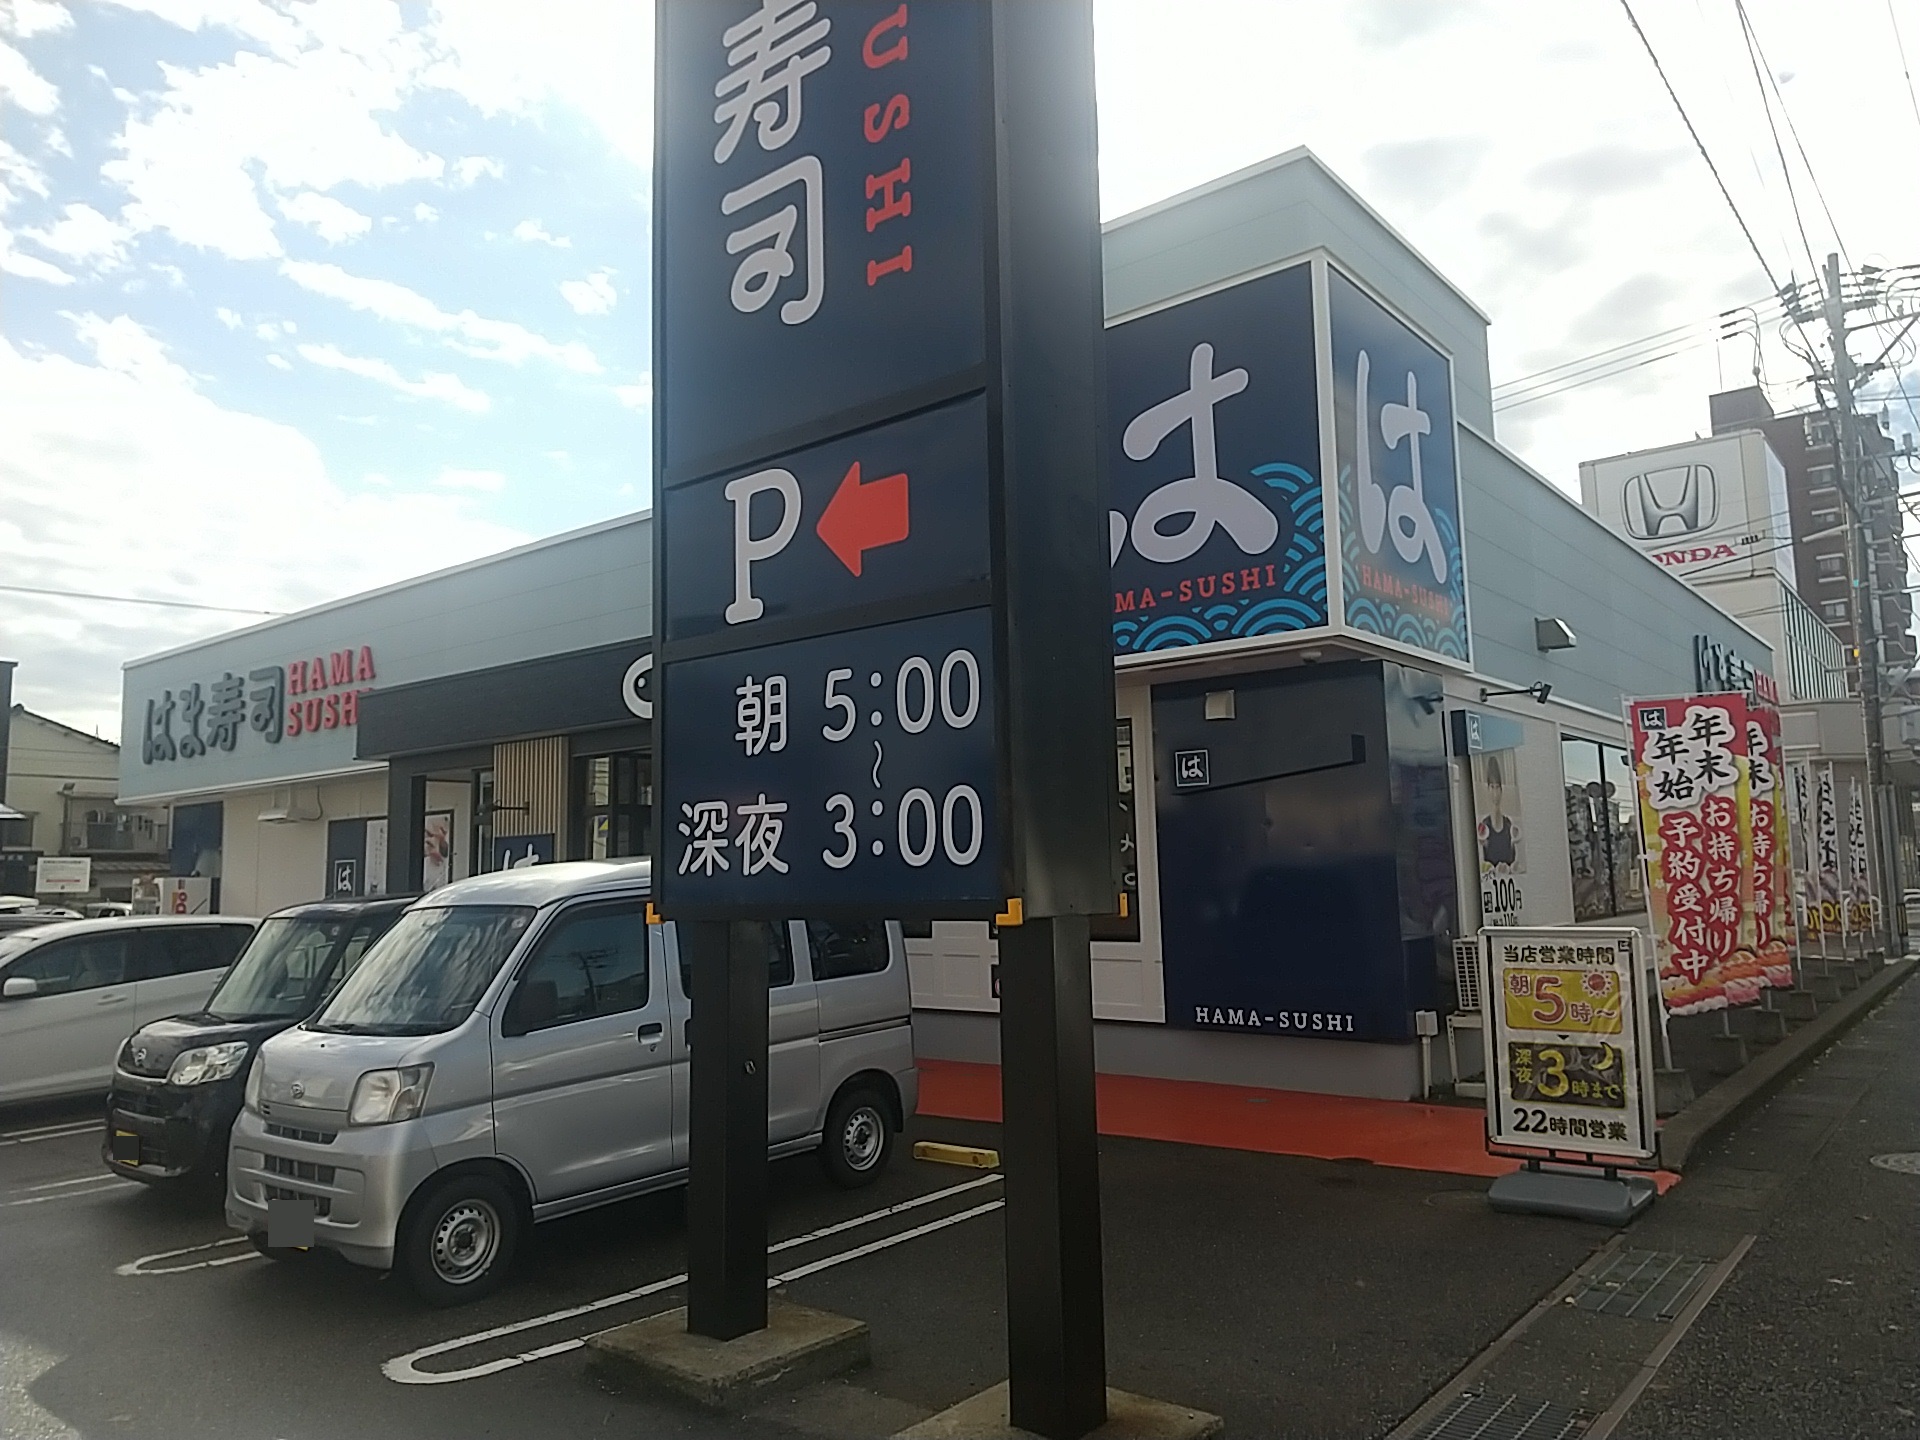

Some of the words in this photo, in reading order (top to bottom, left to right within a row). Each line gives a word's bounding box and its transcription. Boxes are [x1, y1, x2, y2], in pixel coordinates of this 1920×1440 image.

[714, 0, 831, 325] 寿司
[1357, 349, 1448, 585] は
[725, 468, 802, 625] P
[1114, 564, 1276, 613] MA-SUSHI
[1362, 564, 1449, 618] HAMA-SUSHI
[288, 645, 376, 696] HAMA
[735, 674, 788, 757] 朝
[822, 649, 979, 742] 5:00
[142, 665, 284, 765] はま寿司
[287, 689, 372, 737] SUSH
[1642, 711, 1664, 728] は
[1181, 755, 1204, 779] は
[1651, 732, 1696, 802] 年始
[1687, 713, 1731, 785] 年末
[678, 793, 789, 877] 深夜
[822, 784, 983, 869] 3:00
[1664, 817, 1709, 981] 予約受付中
[1704, 800, 1738, 957] お持ち帰り
[1503, 944, 1615, 965] 当店営業時間
[1195, 1006, 1353, 1032] HAMA-SUSHI
[1513, 1107, 1629, 1141] 22時間営業
